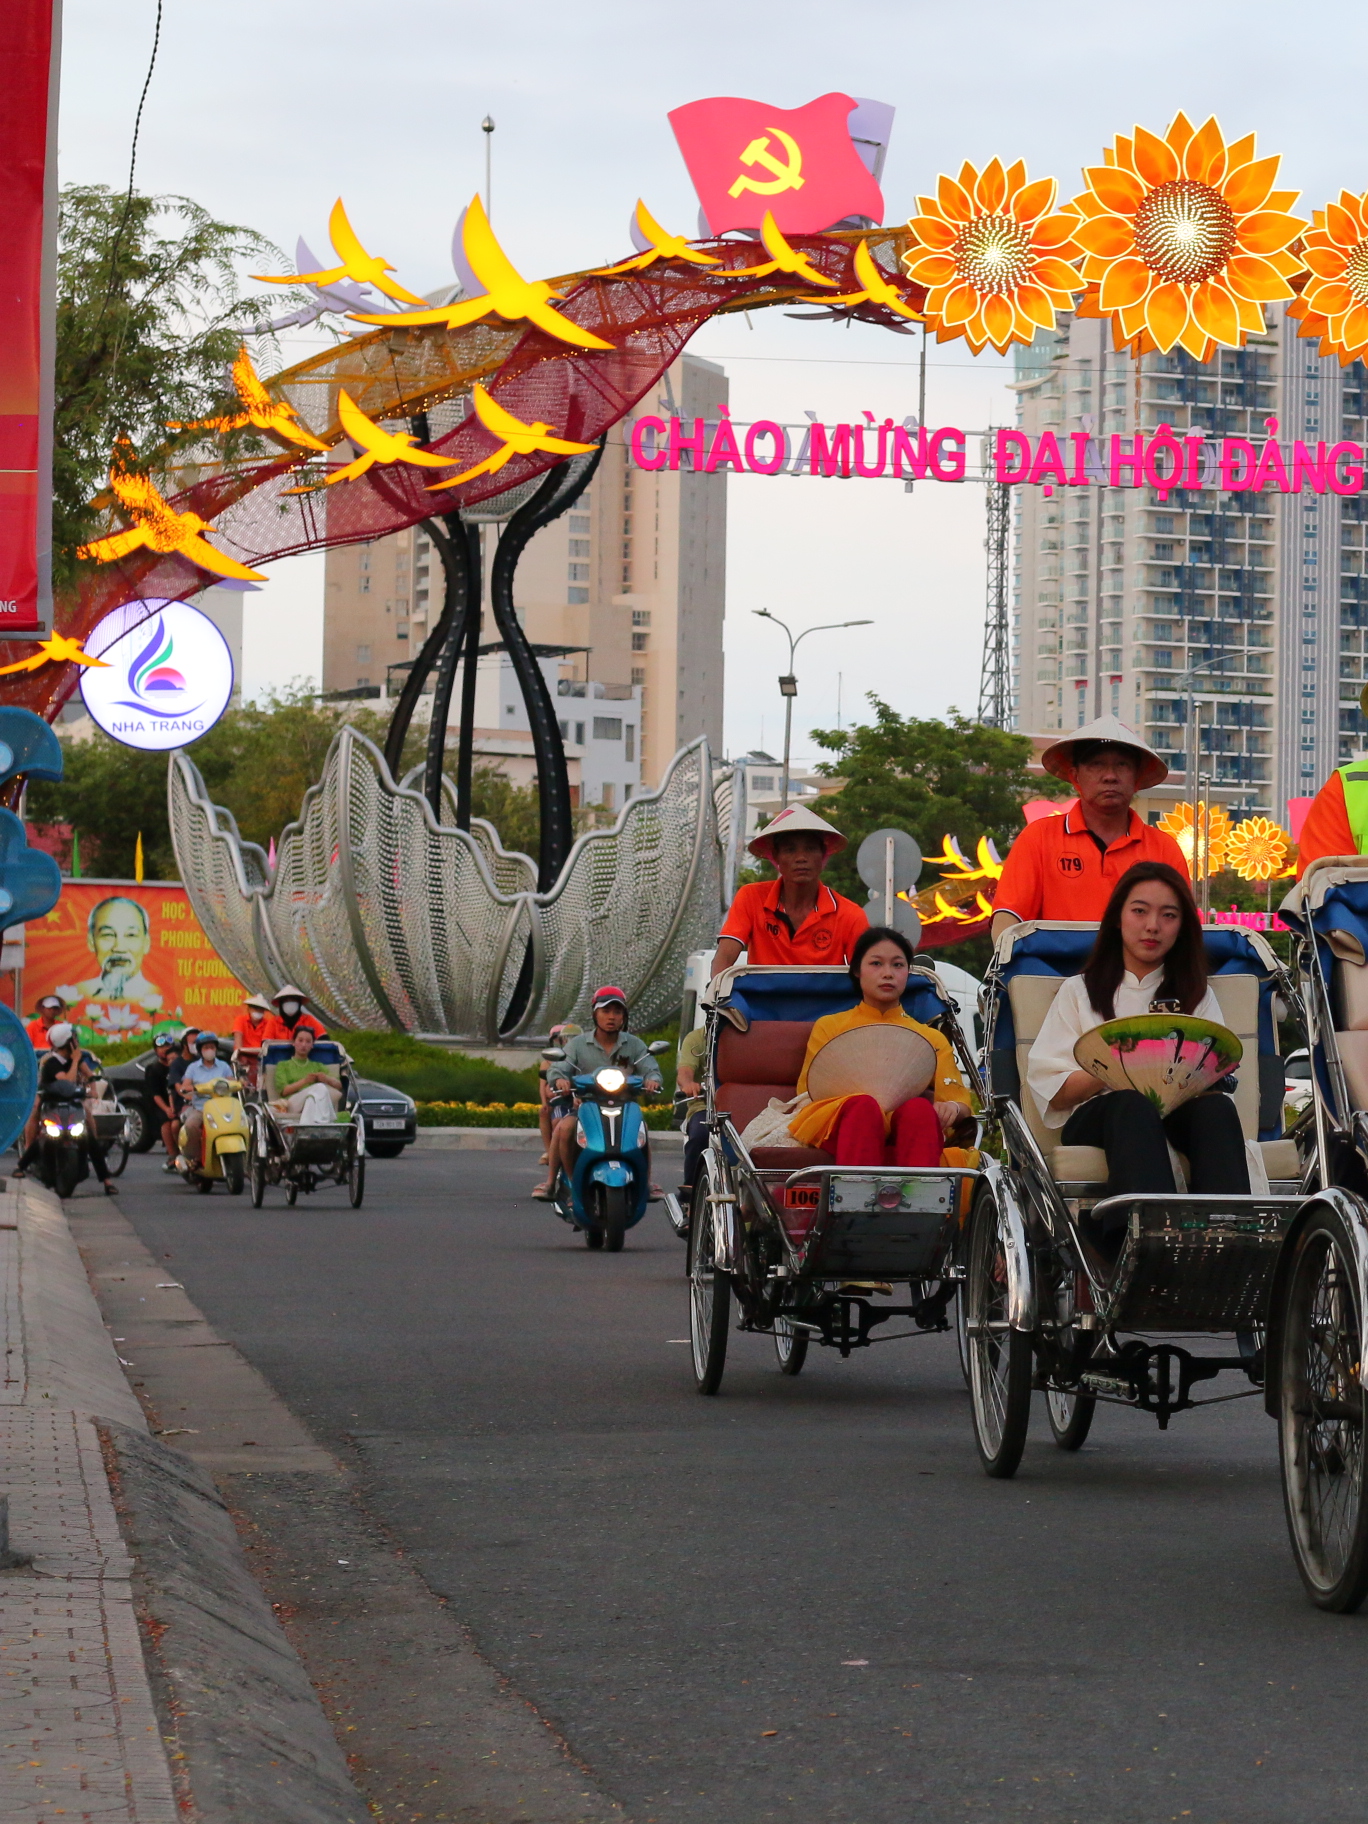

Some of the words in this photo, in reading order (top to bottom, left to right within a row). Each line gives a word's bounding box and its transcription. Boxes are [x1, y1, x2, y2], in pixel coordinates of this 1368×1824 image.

[630, 404, 786, 475] CHÀO
[809, 410, 966, 482] MỪNG
[992, 429, 1091, 497] ĐẠI
[1108, 423, 1205, 502] HỘI
[1218, 416, 1365, 496] ĐẢNG
[112, 721, 146, 732] NHA
[148, 720, 205, 732] TRANG
[1059, 857, 1083, 872] 179
[160, 930, 201, 949] PHONG
[790, 1190, 819, 1206] 106
